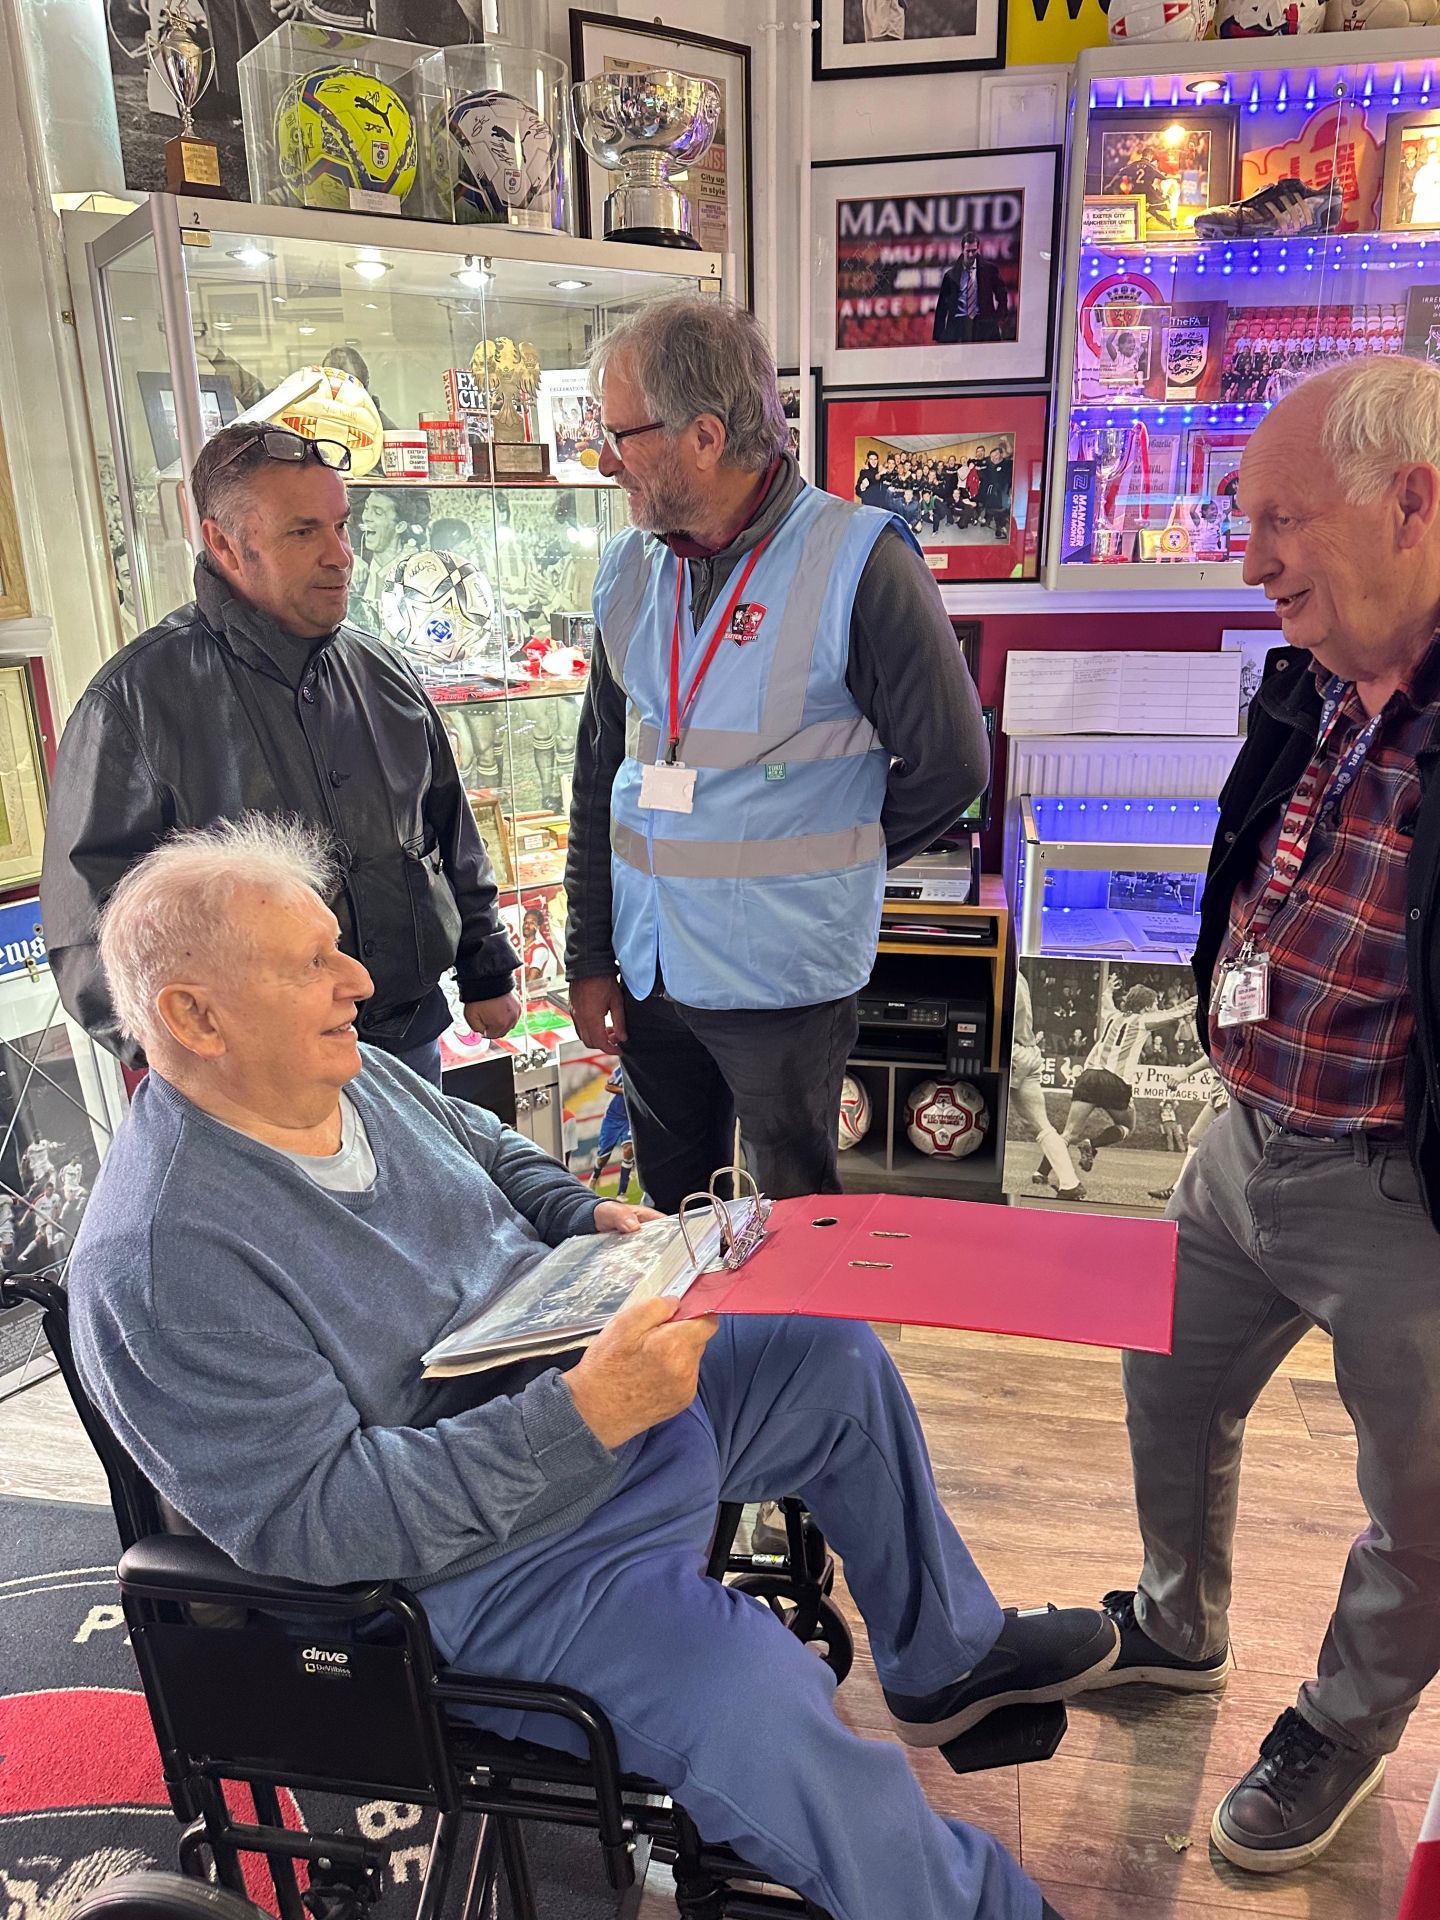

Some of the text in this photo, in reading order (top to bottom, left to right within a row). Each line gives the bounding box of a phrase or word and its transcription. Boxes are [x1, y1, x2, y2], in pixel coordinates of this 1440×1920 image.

[1351, 10, 1357, 18] 5
[700, 173, 724, 185] City up
[708, 186, 726, 196] style
[193, 212, 200, 224] 2
[840, 195, 1021, 237] MANUTD
[710, 263, 715, 274] 2
[1076, 494, 1088, 546] MANAGER
[1069, 519, 1077, 547] MONTH
[1200, 572, 1204, 580] 7
[1334, 682, 1344, 694] EFL
[1322, 712, 1330, 724] EFL
[1348, 754, 1360, 766] EFL
[1332, 783, 1344, 796] EFL
[1200, 1072, 1212, 1084] &
[302, 1647, 348, 1664] drive
[316, 1664, 350, 1674] DeVilbiss
